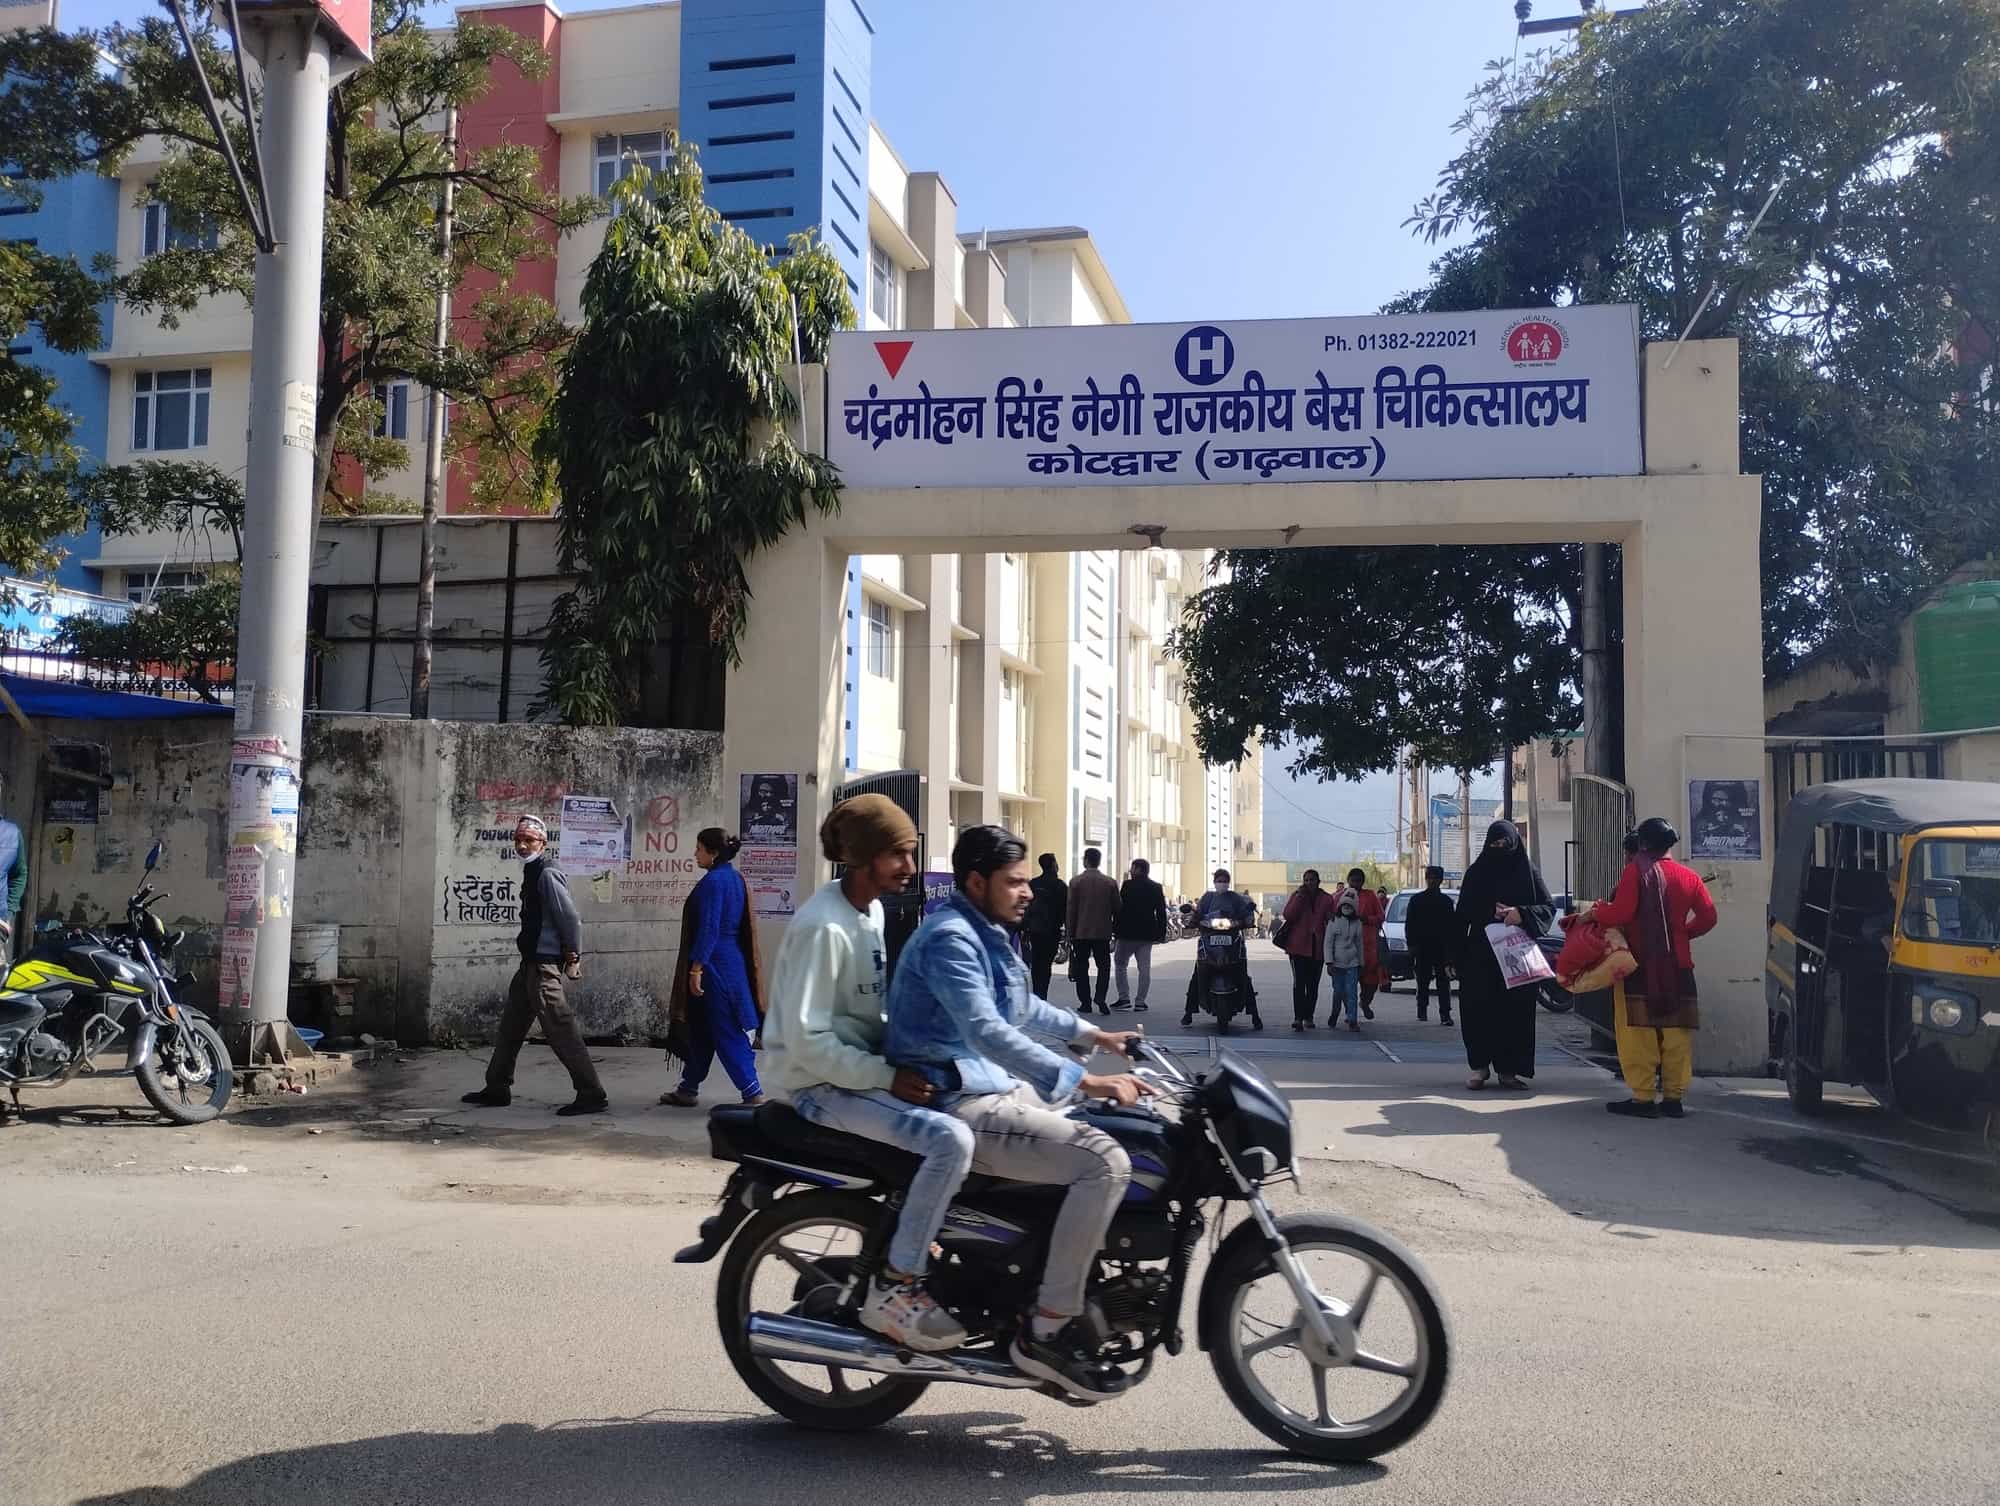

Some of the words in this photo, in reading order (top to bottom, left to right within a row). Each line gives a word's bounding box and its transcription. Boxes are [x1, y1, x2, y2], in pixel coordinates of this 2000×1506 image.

[1324, 335, 1351, 352] Ph.
[1358, 329, 1477, 351] 01382-222021
[844, 380, 987, 450] चंद्रमोहन
[995, 376, 1064, 443] सिंह
[1072, 374, 1145, 437] नेगी
[1153, 370, 1297, 436] राजकीय
[1304, 369, 1365, 432] बेस
[1373, 364, 1591, 430] चिकित्सालय
[1026, 443, 1183, 477] कोटद्वार
[1195, 436, 1387, 480] (गढ़वाल)
[645, 831, 678, 853] NO
[626, 858, 694, 874] PARKING
[458, 901, 518, 922] तिपहिया
